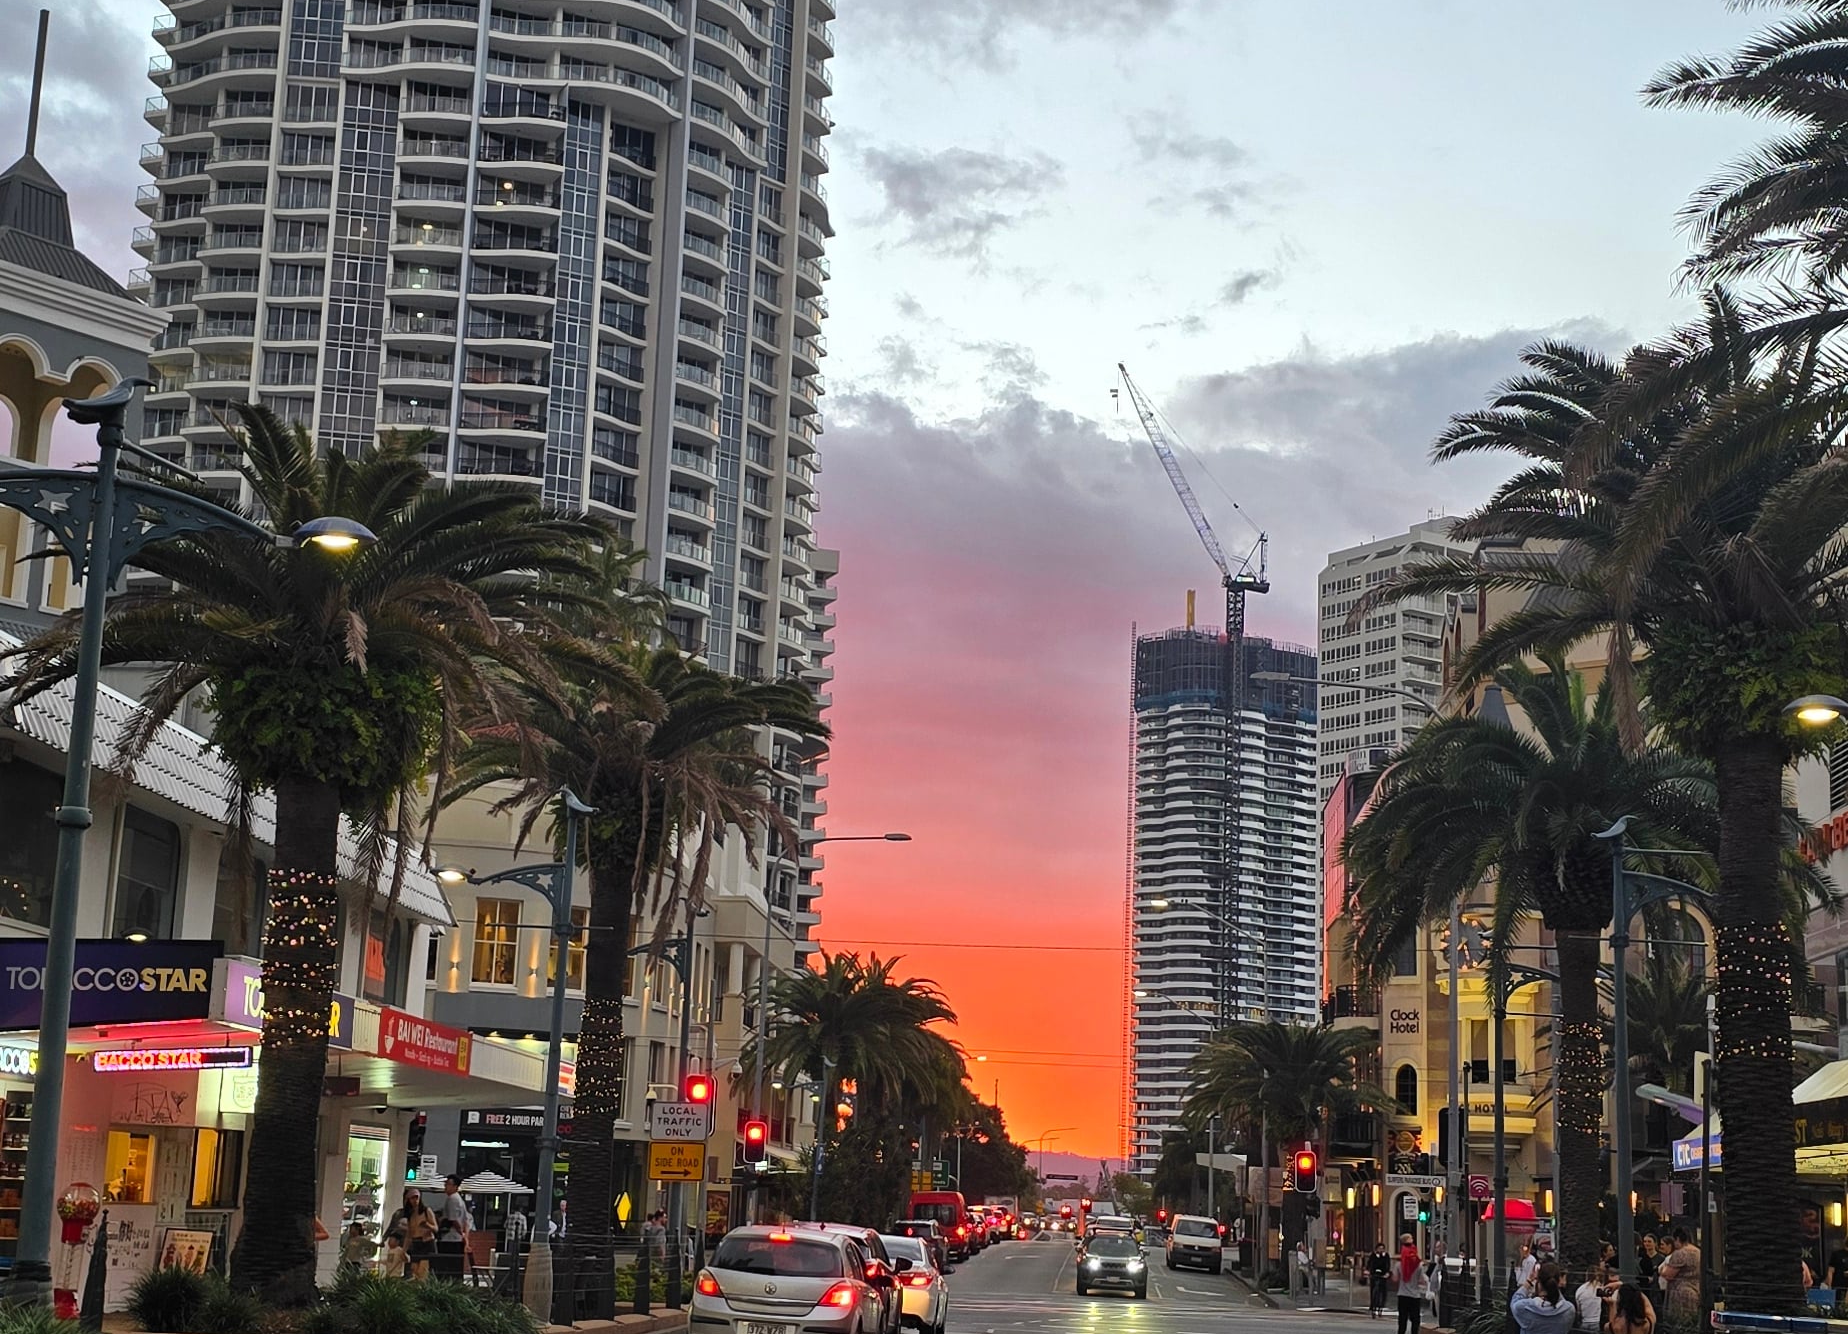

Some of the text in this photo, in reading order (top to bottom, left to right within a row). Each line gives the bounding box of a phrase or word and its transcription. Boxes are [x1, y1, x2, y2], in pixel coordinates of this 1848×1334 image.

[6, 966, 208, 993] TOCCOSTAR
[1390, 1009, 1420, 1021] Clock
[1390, 1022, 1420, 1034] Hotel
[424, 1027, 458, 1055] Restaurant
[157, 1052, 202, 1066] STAR
[662, 1107, 697, 1115] LOCAL
[1475, 1104, 1511, 1114] HOTL
[486, 1114, 505, 1124] FREE
[505, 1116, 511, 1124] 2
[512, 1116, 530, 1125] HOUR
[657, 1117, 702, 1126] TRAFFIC
[665, 1128, 692, 1136] ONLY
[670, 1147, 684, 1155] ON
[655, 1158, 699, 1167] SIDE ROAD
